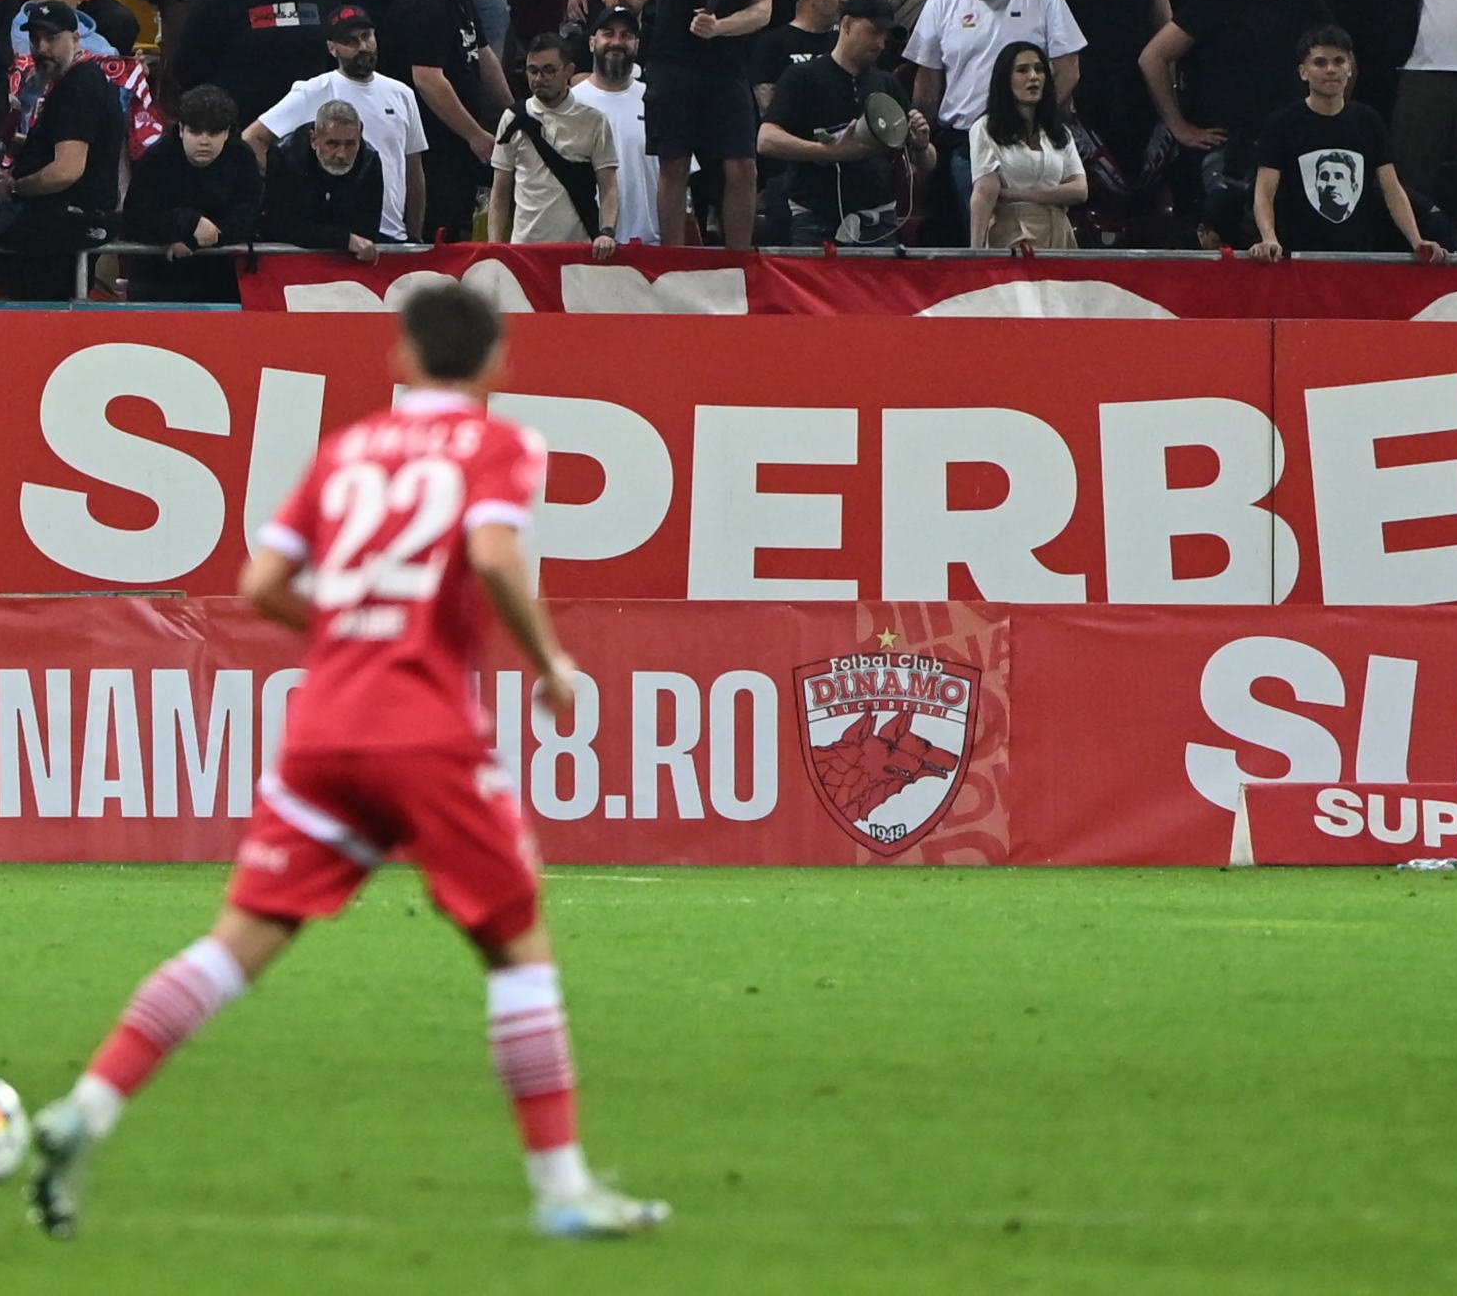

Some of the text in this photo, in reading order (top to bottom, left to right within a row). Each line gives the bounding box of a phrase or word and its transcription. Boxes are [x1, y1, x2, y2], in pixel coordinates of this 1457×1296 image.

[314, 454, 457, 614] 22
[830, 653, 944, 673] Fotbal Club
[811, 671, 965, 704] DINAMO
[867, 823, 905, 841] 1948
